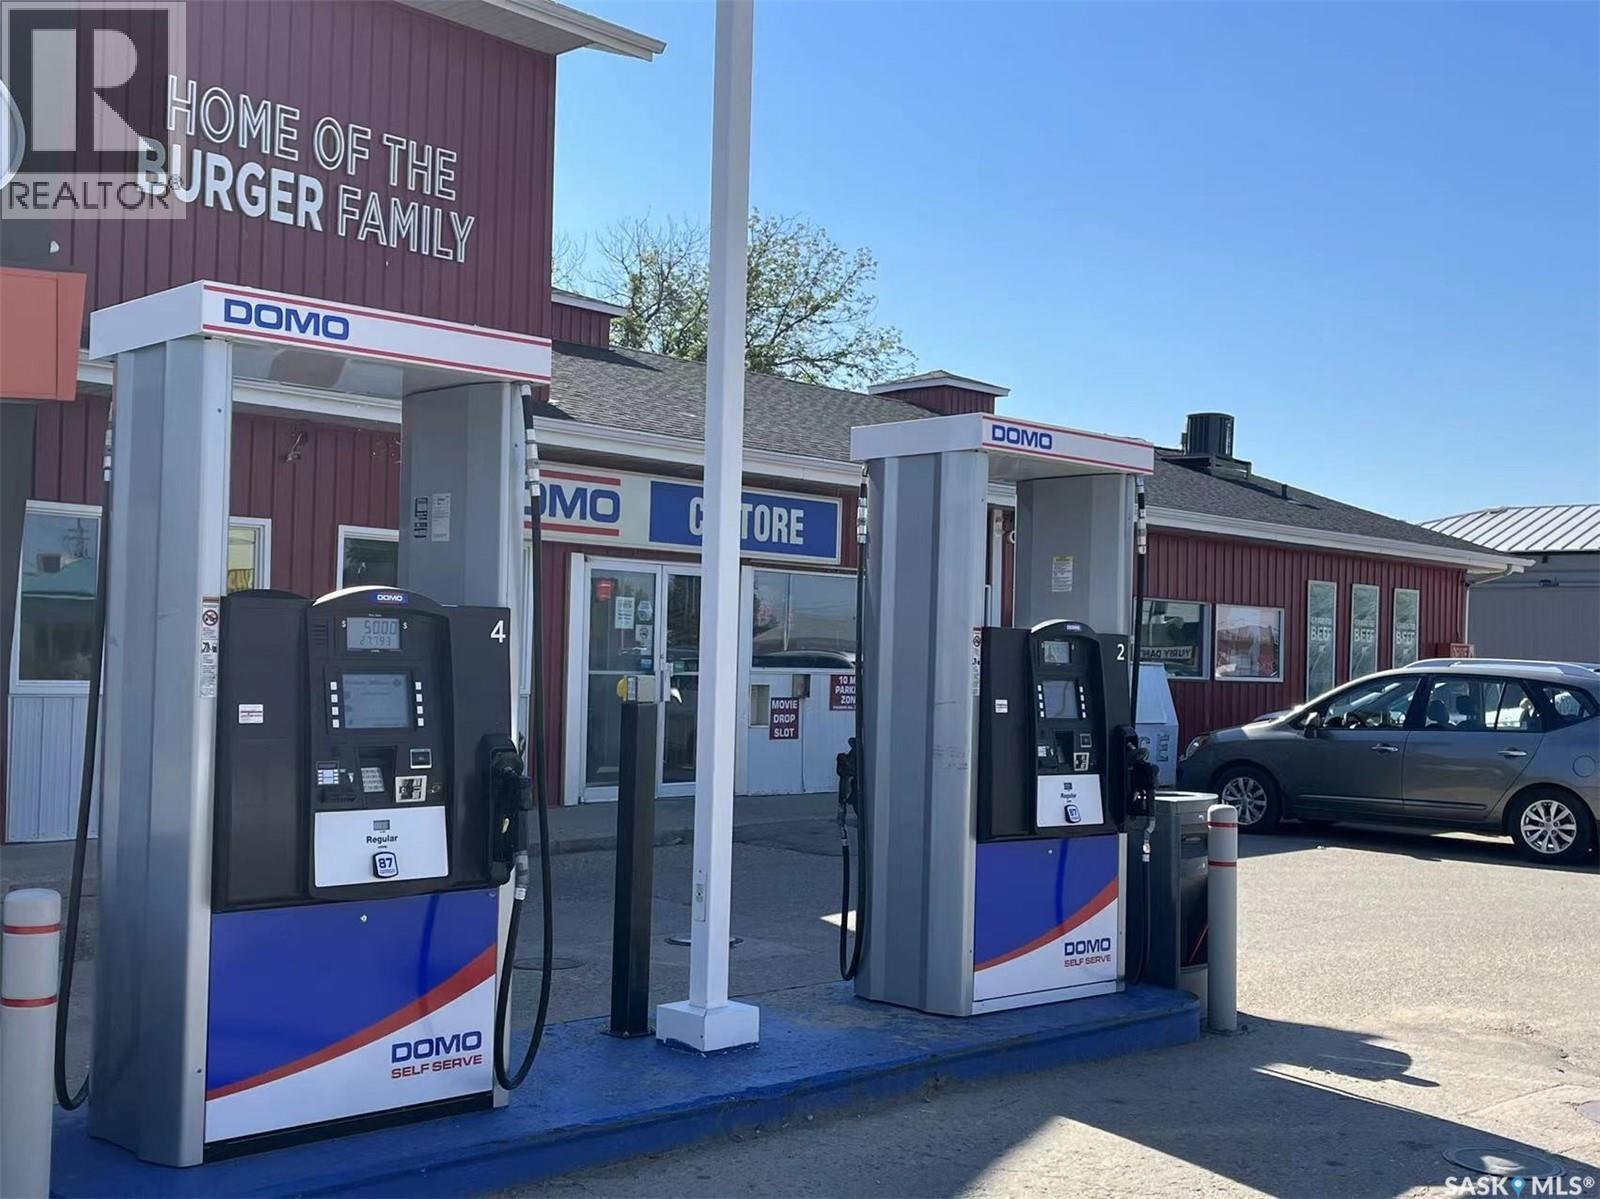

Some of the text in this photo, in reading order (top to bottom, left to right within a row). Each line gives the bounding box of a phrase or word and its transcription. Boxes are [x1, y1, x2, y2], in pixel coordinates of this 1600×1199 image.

[167, 74, 456, 201] HOME OF THE
[136, 135, 475, 263] BURGER FAMILY
[224, 298, 349, 340] DOMO
[992, 424, 1052, 450] DOMO
[741, 503, 804, 545] TORE
[490, 620, 506, 643] 4
[1116, 643, 1125, 661] 2
[838, 675, 848, 685] 10
[835, 686, 857, 695] PARKI
[771, 699, 798, 709] MOVIE
[840, 696, 857, 705] ZON
[773, 713, 796, 724] DROP
[774, 727, 795, 738] SLOT
[366, 834, 399, 844] Regular
[378, 857, 393, 868] 87
[1064, 938, 1111, 956] DOMO
[1064, 954, 1111, 967] SELF SERVE
[391, 1030, 482, 1063] DOMO
[391, 1054, 483, 1079] SELF SERVE
